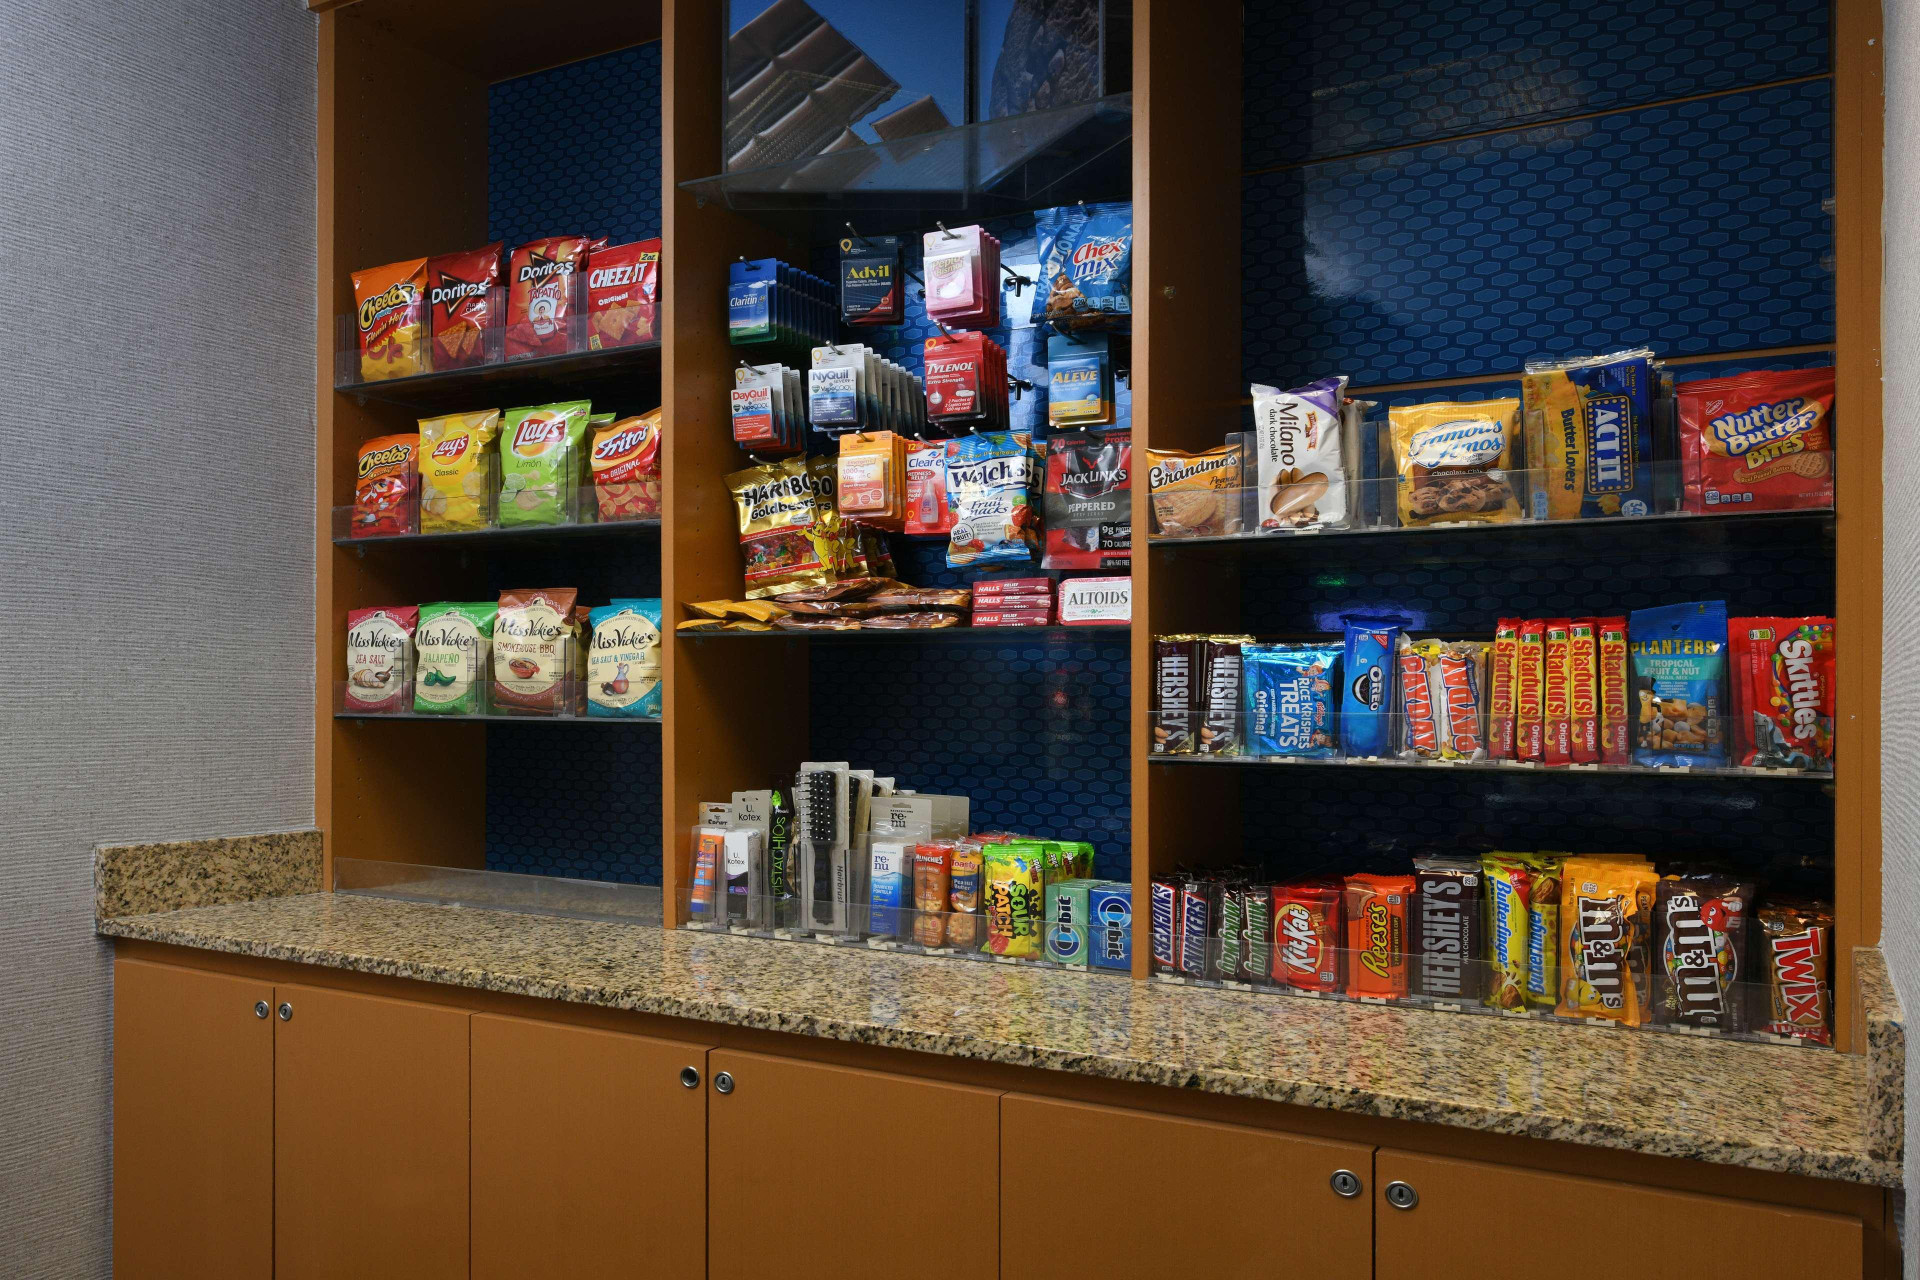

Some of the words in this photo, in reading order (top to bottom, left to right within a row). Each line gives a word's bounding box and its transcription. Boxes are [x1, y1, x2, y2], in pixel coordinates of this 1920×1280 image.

[1074, 238, 1123, 263] Chex
[1075, 253, 1119, 278] mix
[520, 262, 575, 282] Doritos
[846, 265, 890, 279] Advil
[360, 283, 415, 331] Cheetos
[432, 283, 489, 304] Doritos
[730, 297, 758, 307] Claritin
[813, 370, 848, 383] NyQuil
[927, 362, 973, 375] TYLENOL
[1052, 371, 1098, 384] ALEVE
[733, 388, 768, 401] DayQuil
[1269, 408, 1277, 425] dark
[1561, 408, 1576, 449] Butter
[1595, 408, 1620, 451] ACT
[1713, 400, 1801, 438] Nutter
[434, 436, 467, 456] Lay's
[595, 426, 649, 459] Fritos
[1269, 426, 1278, 462] chocolate
[1276, 399, 1301, 466] Milano
[1727, 412, 1813, 454] Butter
[360, 445, 410, 477] Cheetos
[516, 459, 541, 468] Limón
[909, 458, 935, 468] Clear
[1746, 433, 1804, 469] BITES
[610, 459, 640, 477] ORIGINAL
[952, 462, 1025, 487] Welch's
[1060, 474, 1089, 486] JACK
[1090, 469, 1127, 482] LINK'S
[1149, 455, 1237, 489] Grandma's
[1564, 451, 1579, 492] Lovers
[971, 497, 1003, 509] Fruit
[1068, 502, 1116, 513] PEPPERED
[953, 528, 968, 537] REAL
[1102, 526, 1114, 535] 9g
[1102, 540, 1112, 548] 70
[1068, 591, 1128, 605] ALTOIDS
[348, 632, 370, 647] Miss
[370, 628, 401, 652] Vickie's
[418, 631, 439, 647] Miss
[439, 627, 476, 651] Vickie's
[495, 618, 528, 637] Miss
[528, 617, 562, 641] Vickie's
[591, 632, 615, 649] Miss
[614, 626, 654, 650] Vickie's
[356, 654, 367, 664] SEA
[369, 655, 385, 664] SALT
[424, 653, 460, 664] JALAPEÑO
[498, 642, 536, 653] SMOKEHOUSE
[540, 644, 555, 655] BBQ
[600, 655, 612, 664] SALT
[620, 652, 645, 661] VINEGAR
[1630, 640, 1718, 655] PLANTERS
[1494, 642, 1515, 719] Starburst
[1520, 645, 1542, 722] Starburst
[1548, 643, 1568, 720] Starburst
[1573, 639, 1595, 717] Starburst
[1604, 642, 1627, 722] Starburst
[1644, 667, 1671, 675] FRUIT
[1673, 667, 1680, 675] &
[1681, 667, 1701, 675] NUT
[1162, 657, 1188, 740] HERSHEY'S
[1209, 656, 1240, 741] HERSHEY'S
[1297, 678, 1311, 701] RICE
[1368, 665, 1382, 711] OREO
[1400, 656, 1437, 751] PAYDAY
[1779, 640, 1821, 740] Skittles
[1279, 680, 1298, 747] TREATS
[1442, 658, 1481, 752] PAYDAY
[1298, 703, 1313, 749] KRISPIES
[1502, 720, 1512, 751] Original
[1531, 725, 1539, 755] Original
[1558, 722, 1567, 753] Original
[1586, 720, 1594, 751] Original
[1617, 725, 1626, 754] Original
[746, 804, 754, 812] U.
[772, 816, 786, 899] PISTACHIOS
[916, 855, 943, 865] MUNCHIES
[952, 860, 976, 870] Toasty
[993, 884, 1014, 937] PATCH
[1010, 884, 1030, 936] SOUR
[1153, 884, 1172, 962] SNICKERS
[1243, 896, 1268, 941] Milky
[1496, 880, 1512, 968] Butterfinger
[1048, 895, 1080, 957] Orbit
[1098, 896, 1132, 959] Orbit
[1183, 896, 1206, 976] SNICKERS
[1360, 902, 1390, 978] Reese's
[1422, 880, 1461, 994] HERSHEY'S
[1243, 941, 1268, 976] Way
[1528, 909, 1547, 994] Butterfinger
